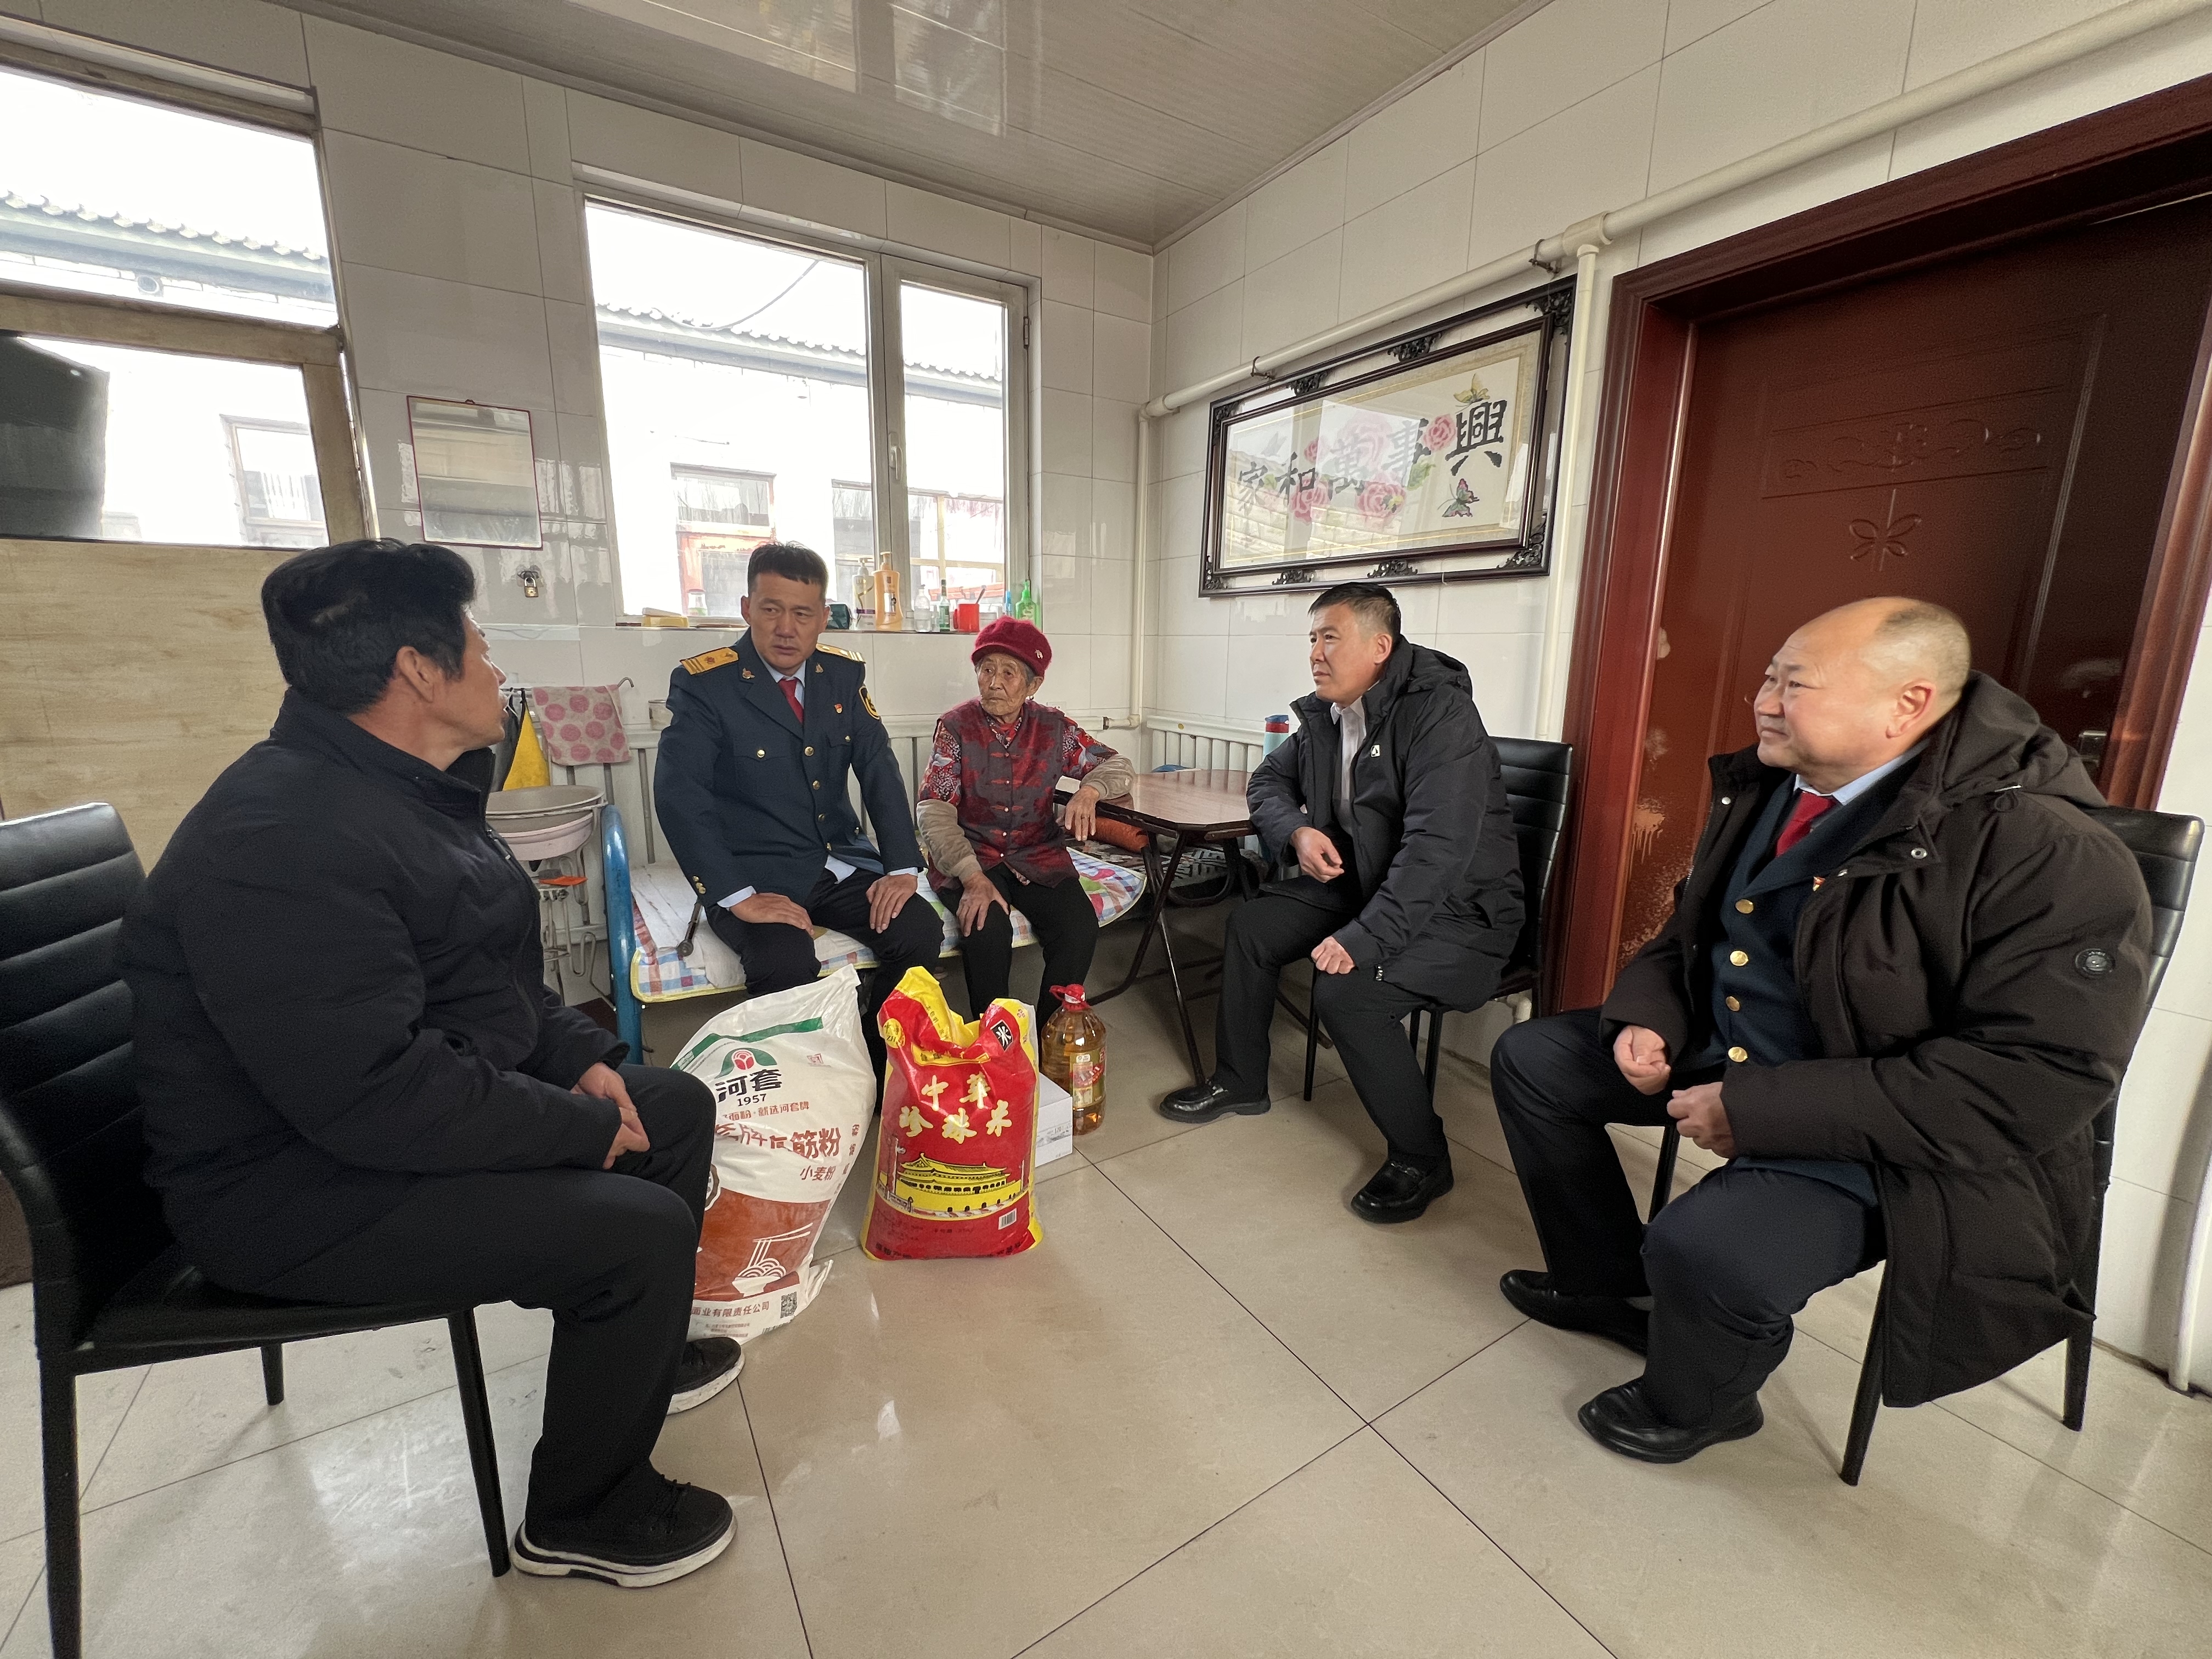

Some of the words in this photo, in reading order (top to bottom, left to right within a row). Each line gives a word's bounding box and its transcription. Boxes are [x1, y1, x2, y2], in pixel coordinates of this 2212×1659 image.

[715, 1069, 782, 1103] 河套
[737, 1093, 767, 1107] 1957
[800, 1165, 837, 1181] 小麦粉
